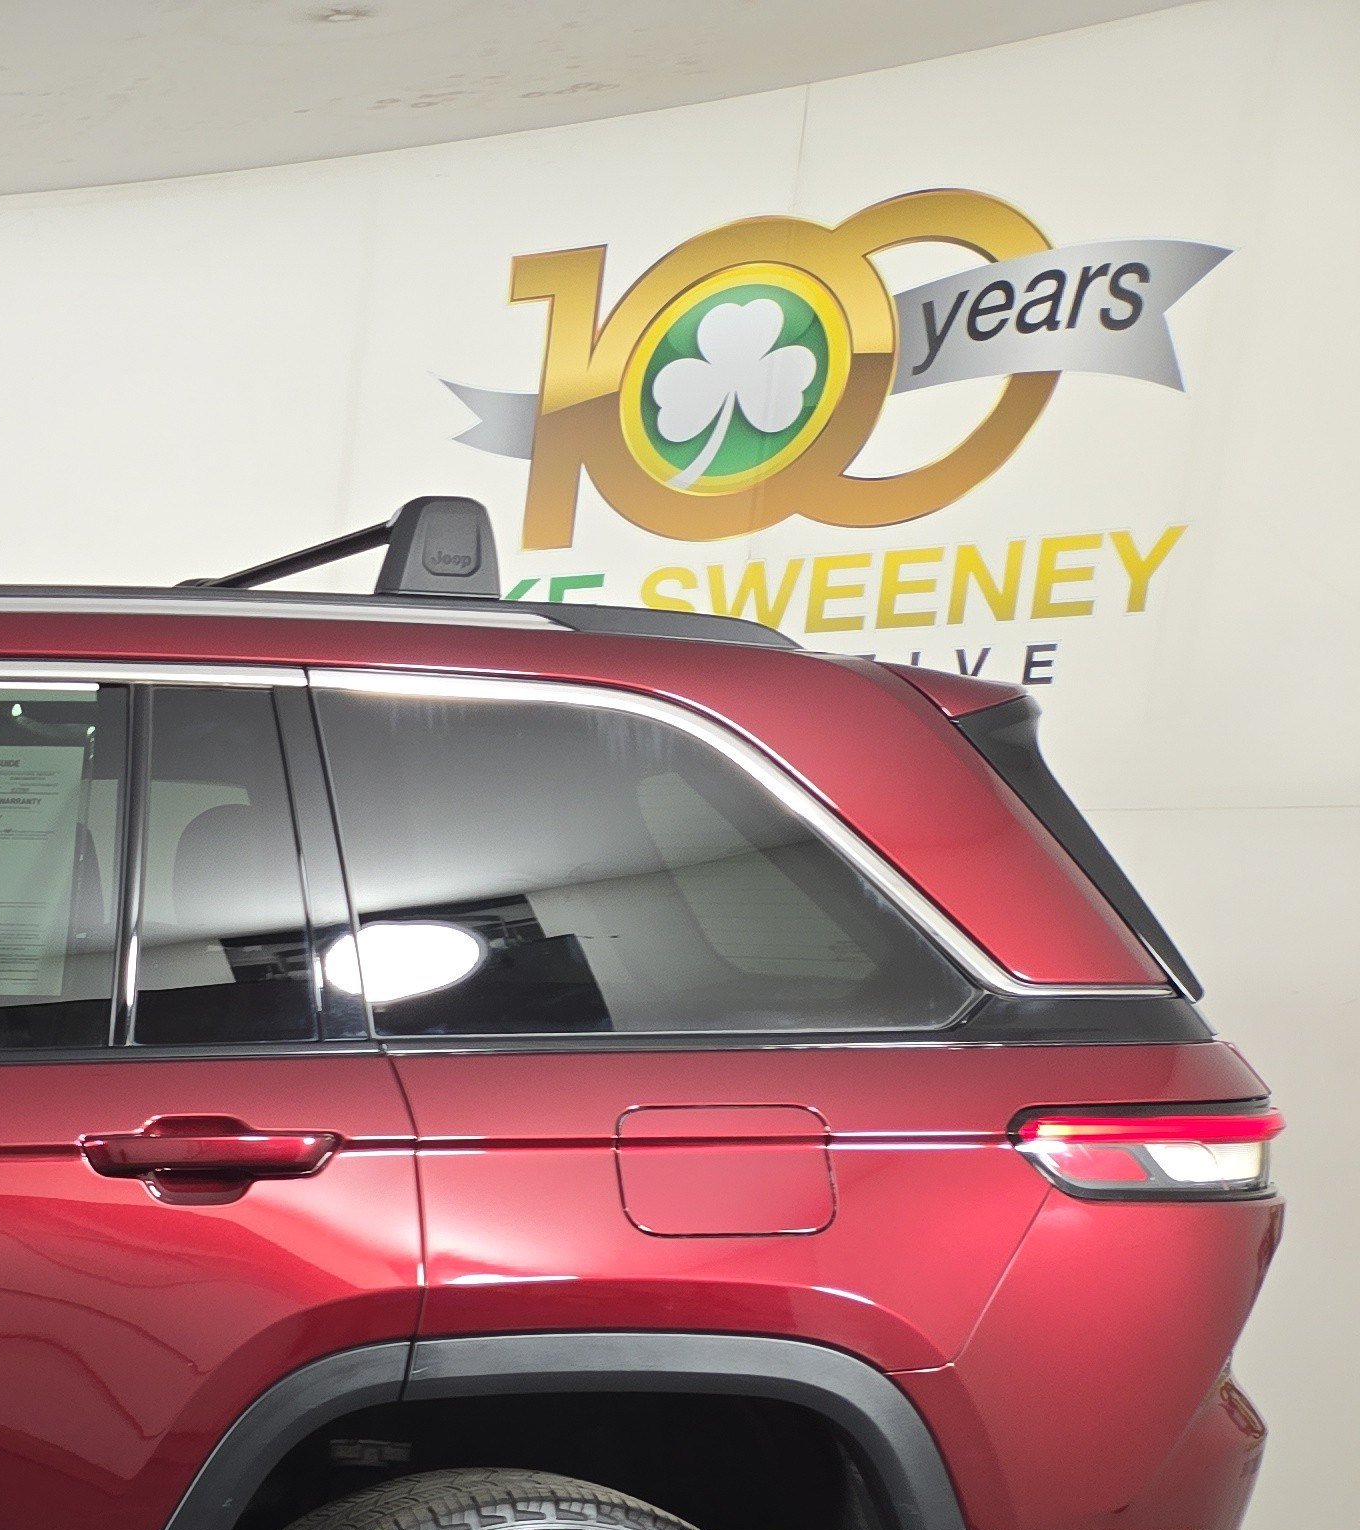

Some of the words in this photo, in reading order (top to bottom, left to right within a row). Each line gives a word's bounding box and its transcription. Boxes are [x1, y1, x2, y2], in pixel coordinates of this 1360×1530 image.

[510, 187, 1062, 551] 100
[911, 260, 1150, 377] years
[430, 550, 473, 569] Jeep
